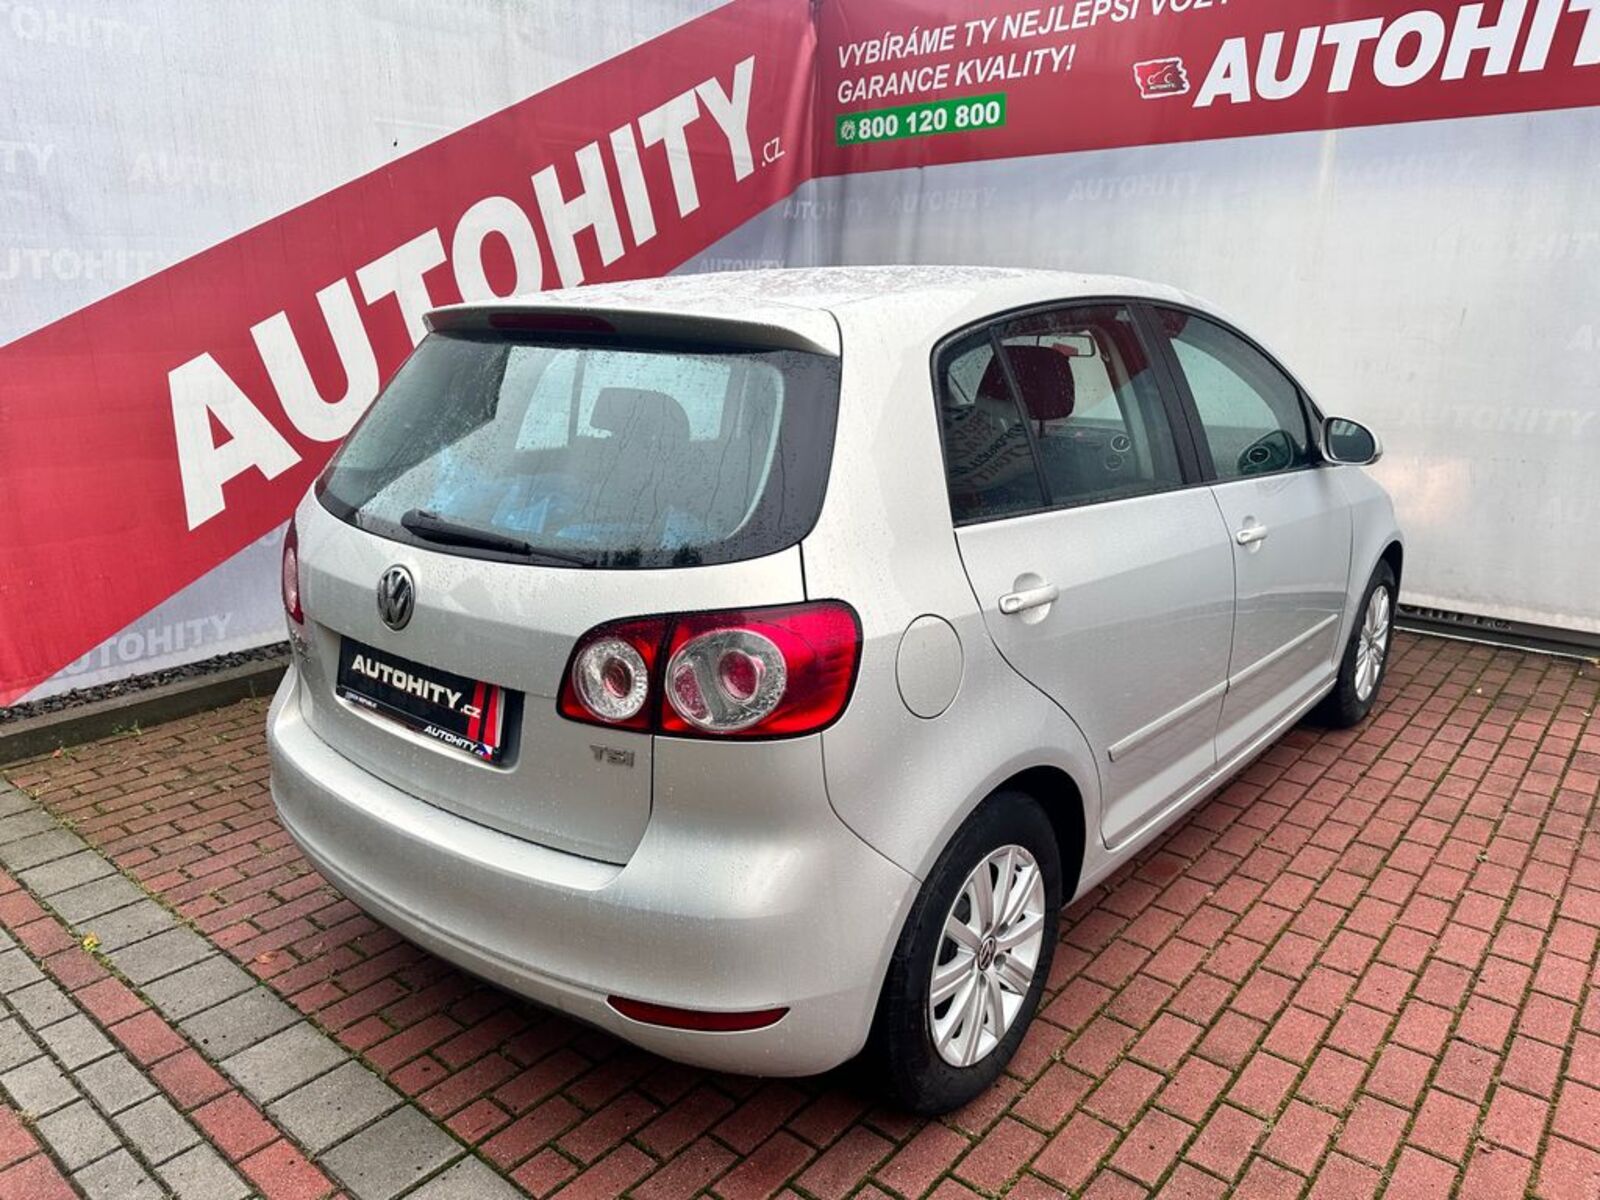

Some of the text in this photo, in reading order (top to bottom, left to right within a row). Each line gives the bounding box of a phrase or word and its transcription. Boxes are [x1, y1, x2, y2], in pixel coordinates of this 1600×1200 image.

[838, 25, 957, 69] VYBÍRÁME
[964, 17, 998, 47] TY
[838, 44, 1076, 104] GARANCE KVALITY!
[858, 101, 1001, 140] 800 120 800
[1067, 170, 1202, 202] AUTOHITY
[589, 744, 635, 768] TSI
